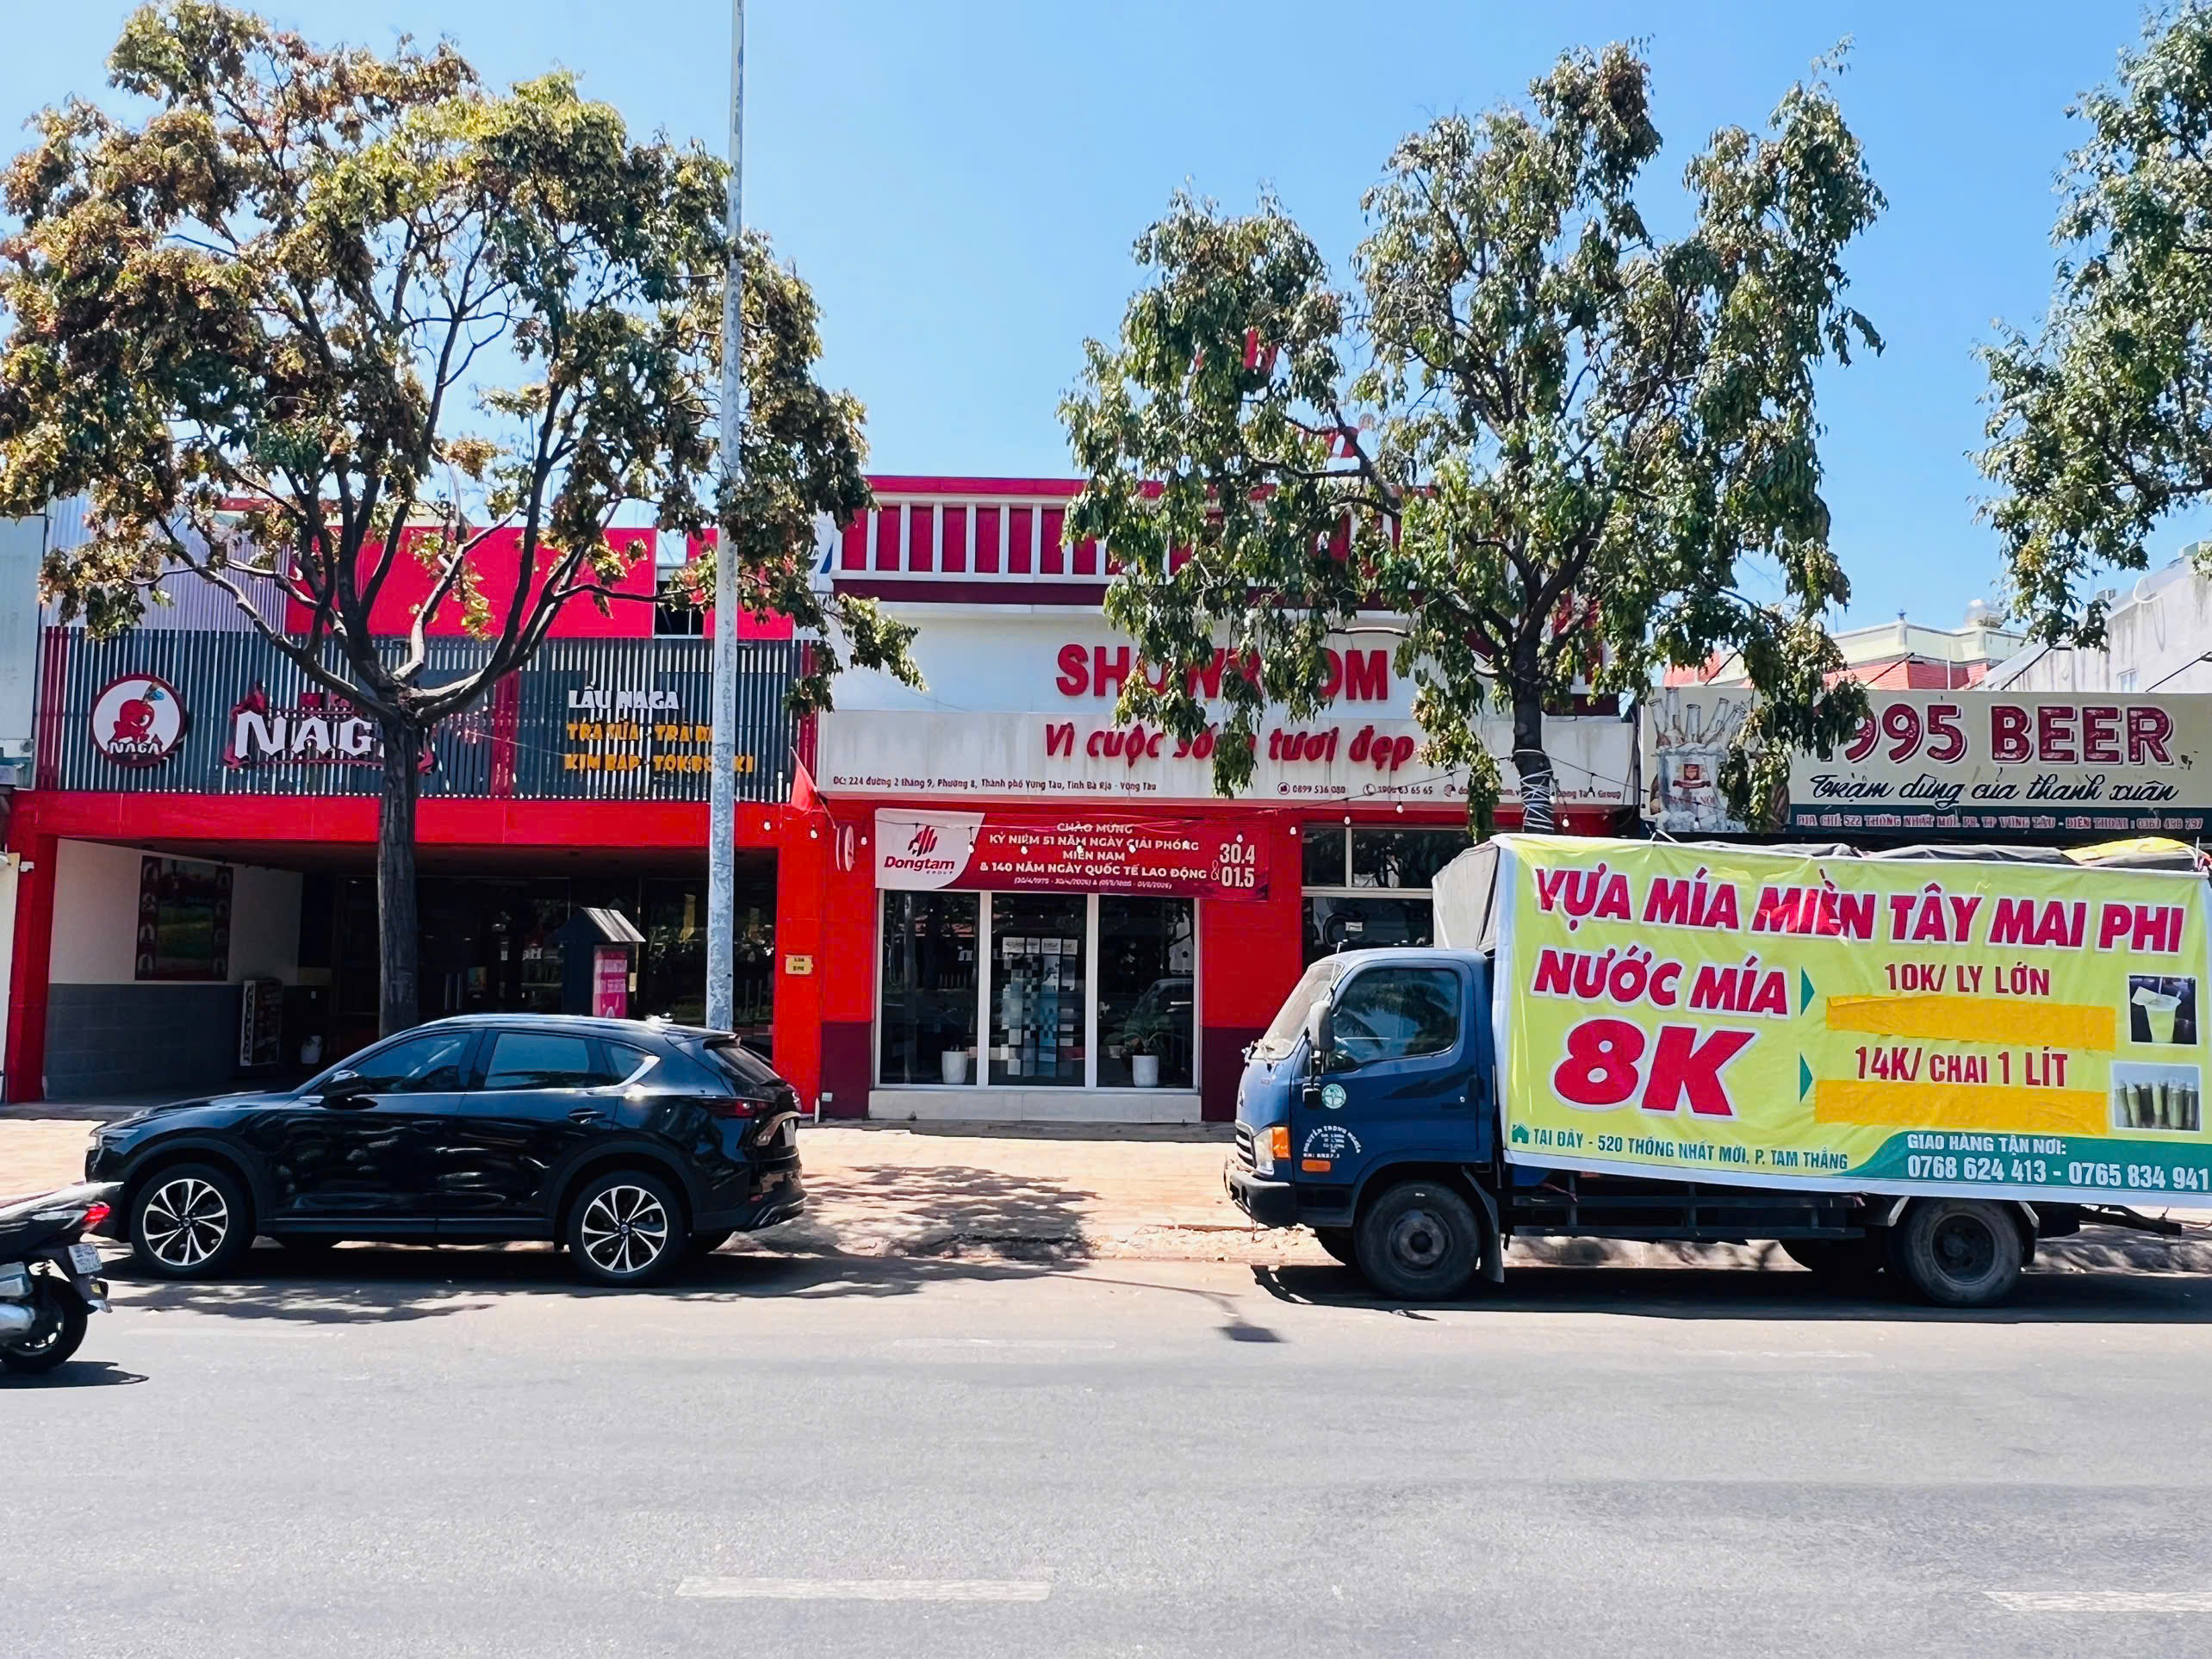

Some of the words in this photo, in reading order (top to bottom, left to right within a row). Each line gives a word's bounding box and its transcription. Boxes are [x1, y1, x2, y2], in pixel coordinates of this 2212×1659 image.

[616, 690, 680, 710] NAGA
[234, 711, 384, 759] NAG
[1813, 702, 1965, 765] 995
[1990, 703, 2173, 767] BEER
[109, 742, 160, 755] NAGA
[1046, 722, 1075, 758] Vì
[1086, 724, 1166, 768] cuộc
[1269, 726, 1339, 762] tươi
[1348, 725, 1414, 772] đẹp
[564, 754, 601, 773] KIM
[605, 754, 641, 772] BAP
[653, 755, 755, 773] TOKBOKI
[848, 776, 864, 786] 224
[893, 778, 899, 786] 2
[1411, 786, 1420, 794] 65
[1423, 786, 1433, 795] 65
[2026, 774, 2103, 802] thanh
[2109, 780, 2179, 802] xuân
[1843, 815, 1862, 827] 522
[1043, 836, 1055, 845] 51
[1058, 835, 1087, 846] NĂM
[1090, 836, 1124, 848] NGÀY
[884, 855, 955, 872] Dongtam
[1097, 851, 1126, 861] NAM
[1219, 842, 1256, 865] 30.4
[991, 862, 1013, 873] 140
[1016, 861, 1045, 873] NĂM
[1047, 861, 1083, 873] NGÀY
[1084, 862, 1121, 876] QUỐC
[1123, 863, 1139, 876] TẾ
[1141, 867, 1167, 877] LAO
[1170, 867, 1207, 880] ĐỘNG
[1210, 860, 1220, 881] &
[1221, 866, 1256, 888] 01.5
[1534, 862, 1632, 932] VỰA
[1643, 867, 1739, 931] MÍA
[1751, 867, 1877, 941] MIỀN
[1889, 882, 1982, 942] TÂY
[1988, 898, 2088, 948] MAI
[2097, 903, 2185, 953] PHI
[1533, 945, 1682, 1007] NƯỚC
[1688, 955, 1788, 1016] MÍA
[1885, 963, 1948, 992] 10K/
[1955, 965, 1984, 993] LY
[1994, 961, 2050, 997] LỚN
[1553, 1018, 1756, 1117] 8K
[1855, 1046, 1923, 1082] 14K/
[1929, 1053, 1988, 1084] CHAI
[1997, 1051, 2010, 1084] 1
[2024, 1046, 2069, 1087] LÍT
[1533, 1128, 1552, 1150] TẠI
[1556, 1128, 1585, 1149] ĐÂY
[1598, 1134, 1623, 1153] 520
[1628, 1134, 1675, 1158] THỐNG
[1679, 1137, 1715, 1161] NHẤT
[1755, 1148, 1766, 1165] P.
[1770, 1149, 1799, 1167] TAM
[1803, 1146, 1849, 1170] THẮNG
[1907, 1134, 1946, 1150] GIAO
[1948, 1133, 1995, 1152] HÀNG
[1998, 1134, 2030, 1155] TẬN
[1907, 1154, 1958, 1179] 0768
[1963, 1156, 2005, 1181] 624
[2010, 1157, 2047, 1183] 413
[2067, 1161, 2122, 1187] 0765
[2127, 1164, 2165, 1189] 834
[2172, 1166, 2209, 1191] 941
